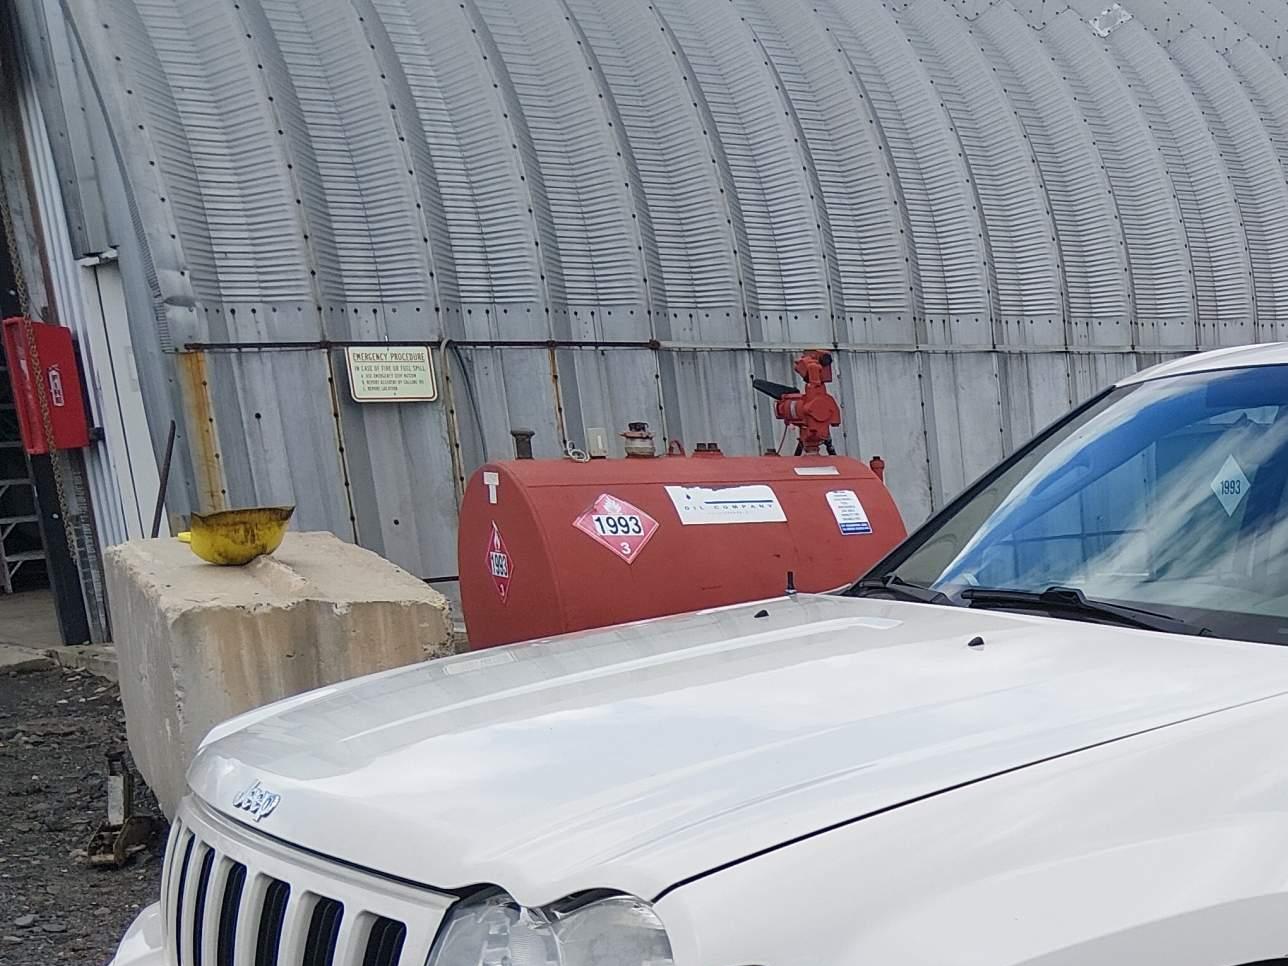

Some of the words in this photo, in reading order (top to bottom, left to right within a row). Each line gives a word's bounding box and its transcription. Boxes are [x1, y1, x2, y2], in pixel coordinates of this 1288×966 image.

[352, 352, 388, 361] EMERGENCY
[390, 352, 425, 361] PROCEDURE
[1220, 480, 1241, 495] 1993
[594, 516, 641, 535] 1993
[620, 542, 631, 554] 3
[490, 553, 508, 577] 1993
[232, 779, 281, 822] Jeep
